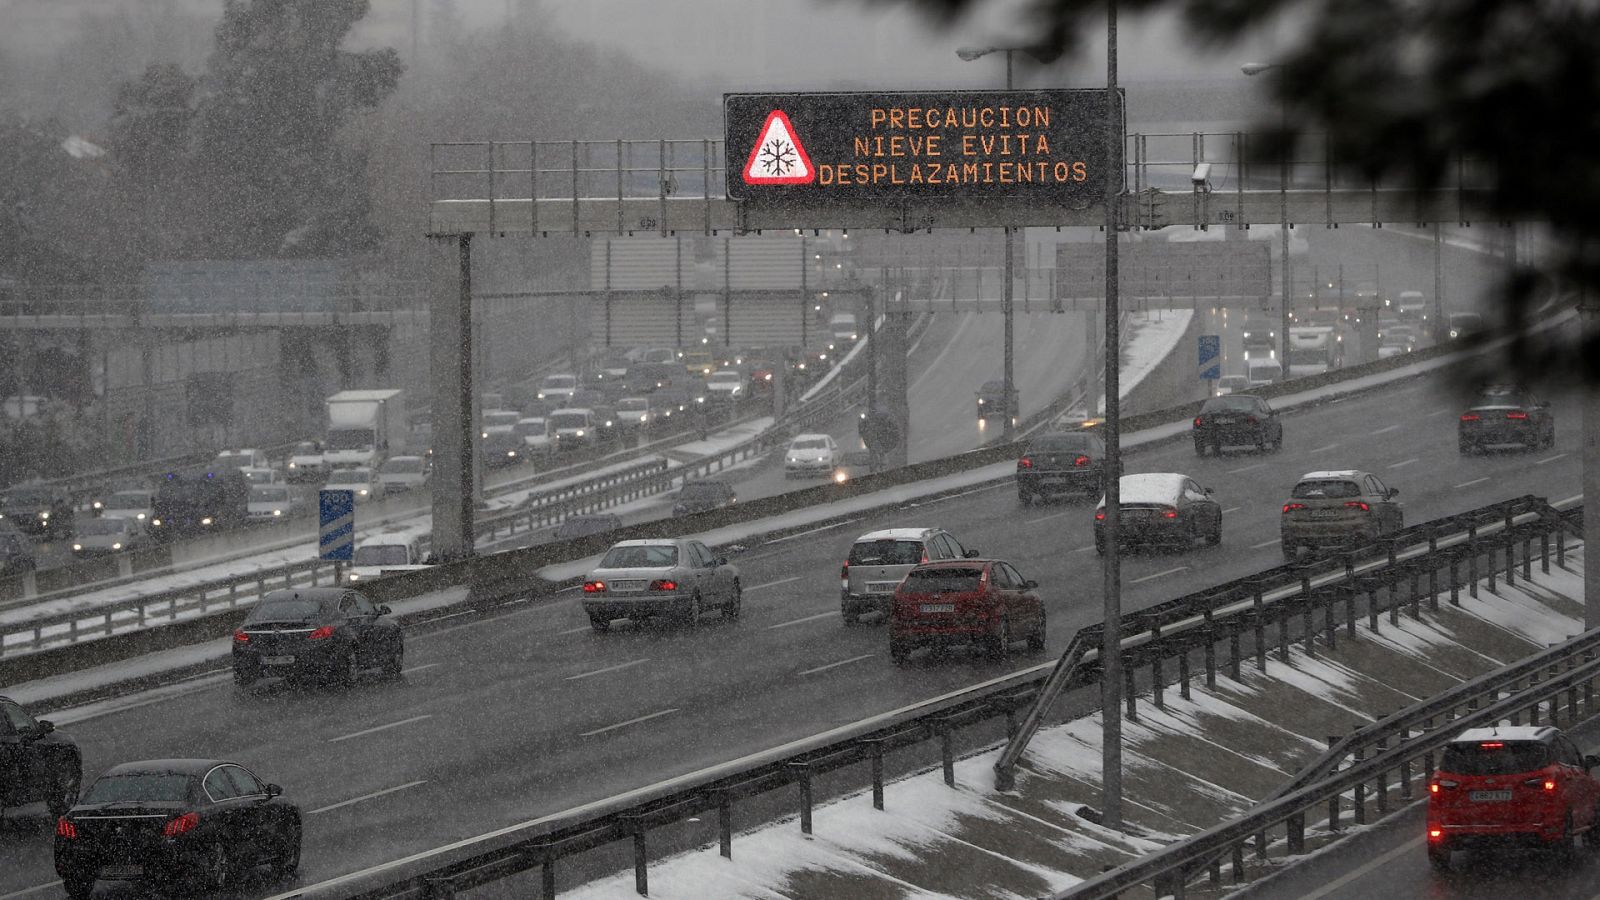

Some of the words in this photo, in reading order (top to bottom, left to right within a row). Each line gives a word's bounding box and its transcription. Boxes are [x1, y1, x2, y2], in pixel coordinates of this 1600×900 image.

[871, 107, 1050, 129] PRECAUCION
[854, 135, 941, 157] NIEVE
[962, 134, 1049, 156] EVITA
[819, 161, 1087, 185] DESPLAZAMIENTOS
